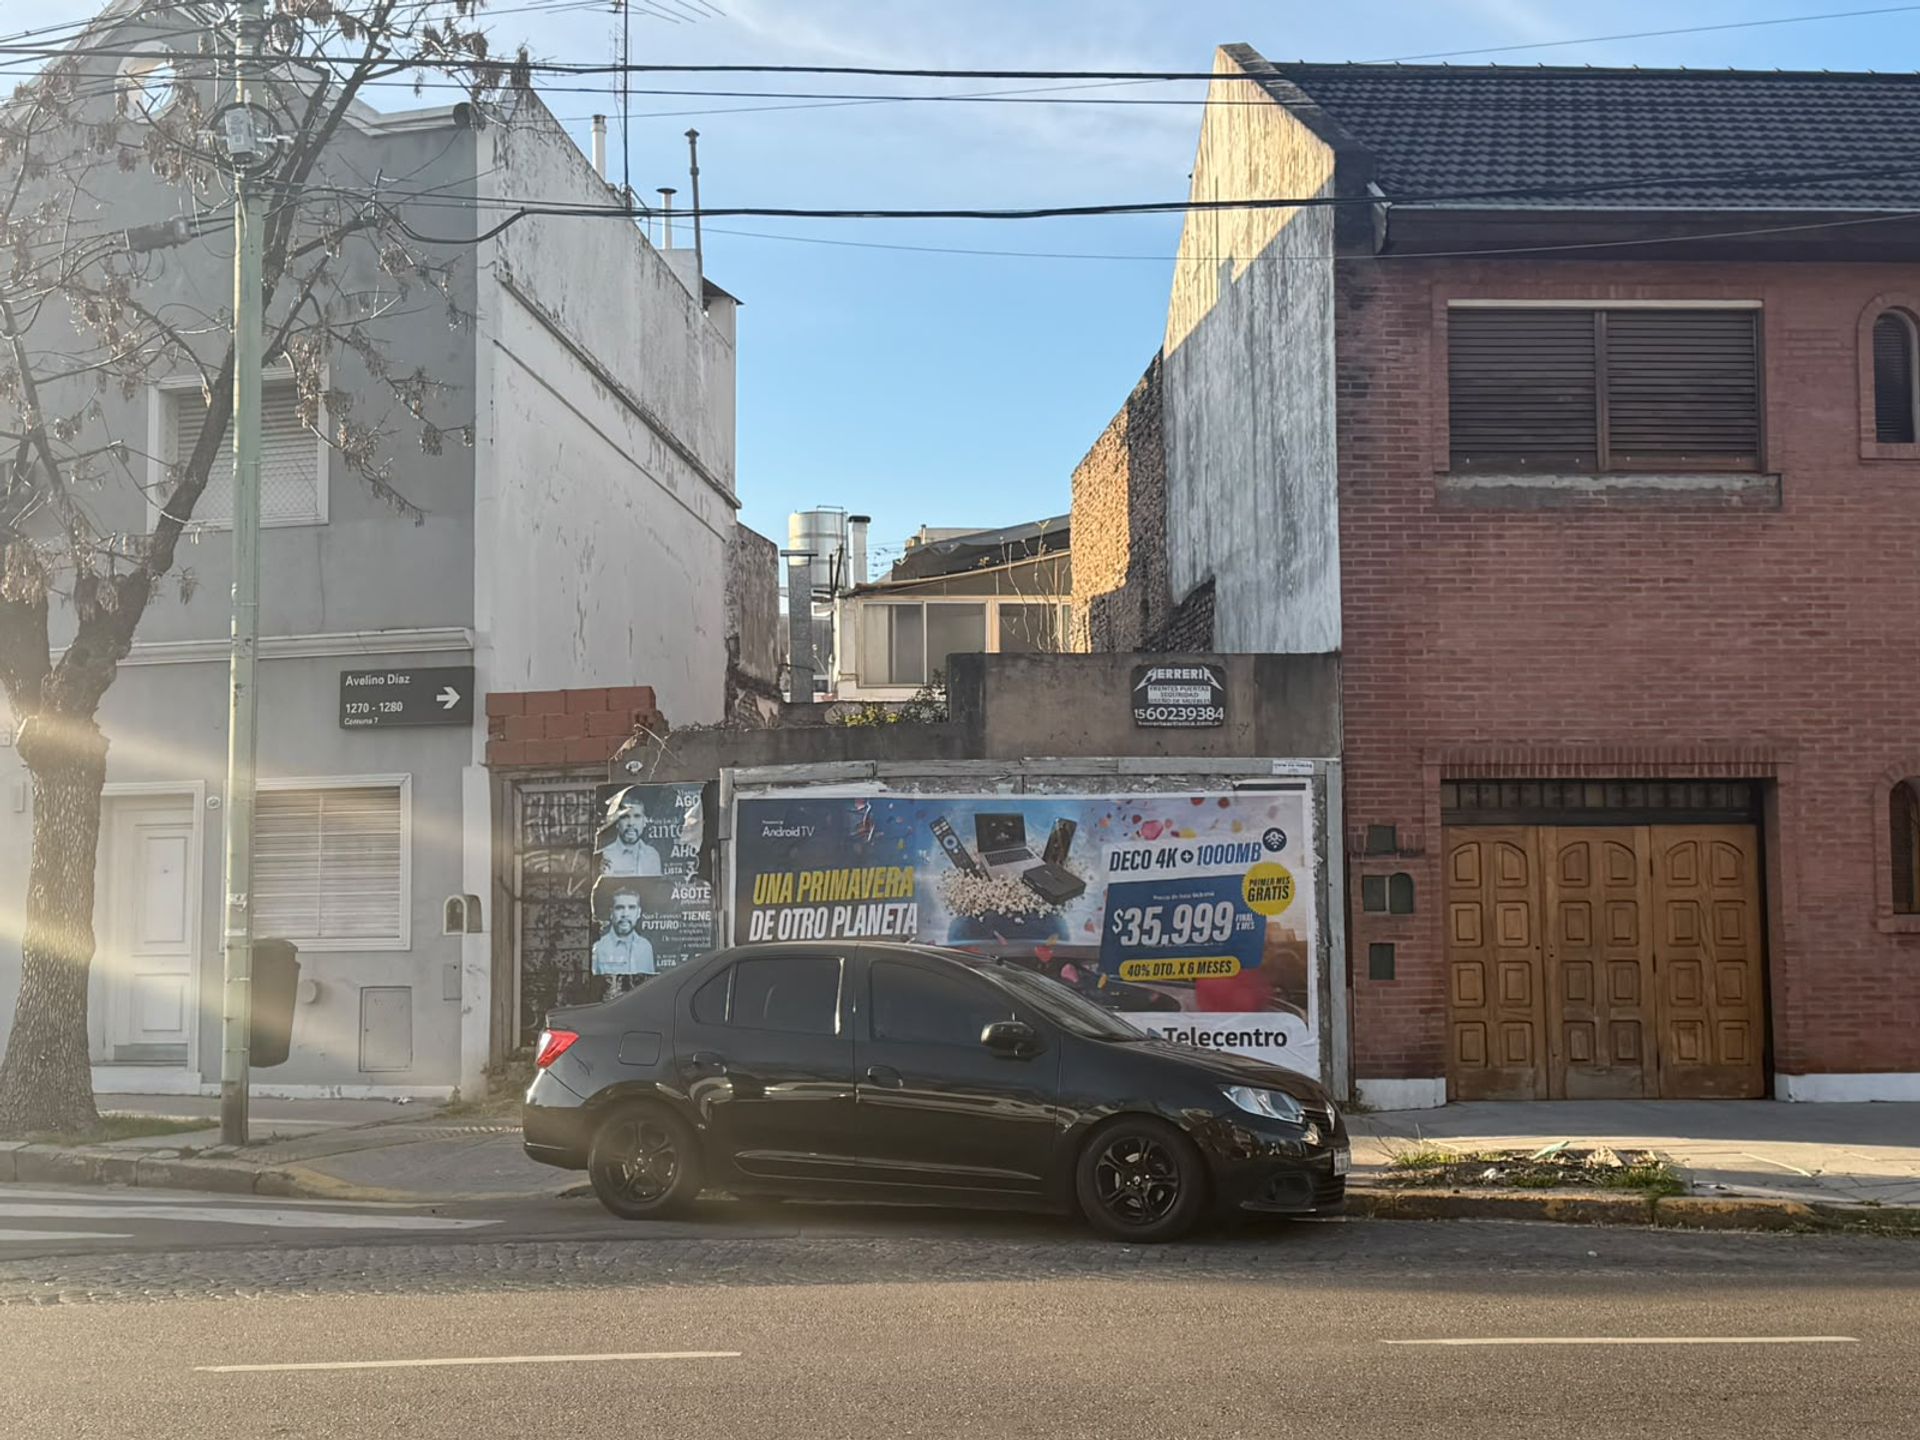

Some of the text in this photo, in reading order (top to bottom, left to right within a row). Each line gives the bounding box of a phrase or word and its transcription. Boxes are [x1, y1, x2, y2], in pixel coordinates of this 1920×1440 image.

[345, 674, 385, 686] Avelino
[1134, 666, 1224, 691] HERRERIA
[345, 702, 370, 714] 1270
[379, 701, 403, 712] 1280
[344, 717, 373, 725] Comuna
[675, 795, 701, 808] AGO
[762, 825, 815, 837] Android TV
[671, 844, 698, 858] AHO
[1109, 850, 1151, 872] DECO
[1155, 847, 1178, 869] 4K
[1197, 842, 1262, 865] 1000MB
[664, 865, 683, 875] LISTA
[753, 866, 915, 905] UNA PRIMAVERA
[1276, 876, 1290, 885] MES
[671, 886, 711, 900] AGOTE
[1248, 885, 1289, 902] GRATIS
[681, 910, 711, 921] TIENE
[749, 902, 918, 941] DE OTRO PLANETA
[1235, 913, 1253, 922] FINAL
[642, 921, 679, 930] FUTURO
[1112, 901, 1234, 946] $35.999
[656, 958, 677, 967] LISTA
[1127, 960, 1232, 976] 40% DTO. X 6 MESES
[1163, 1027, 1287, 1047] Telecentro
